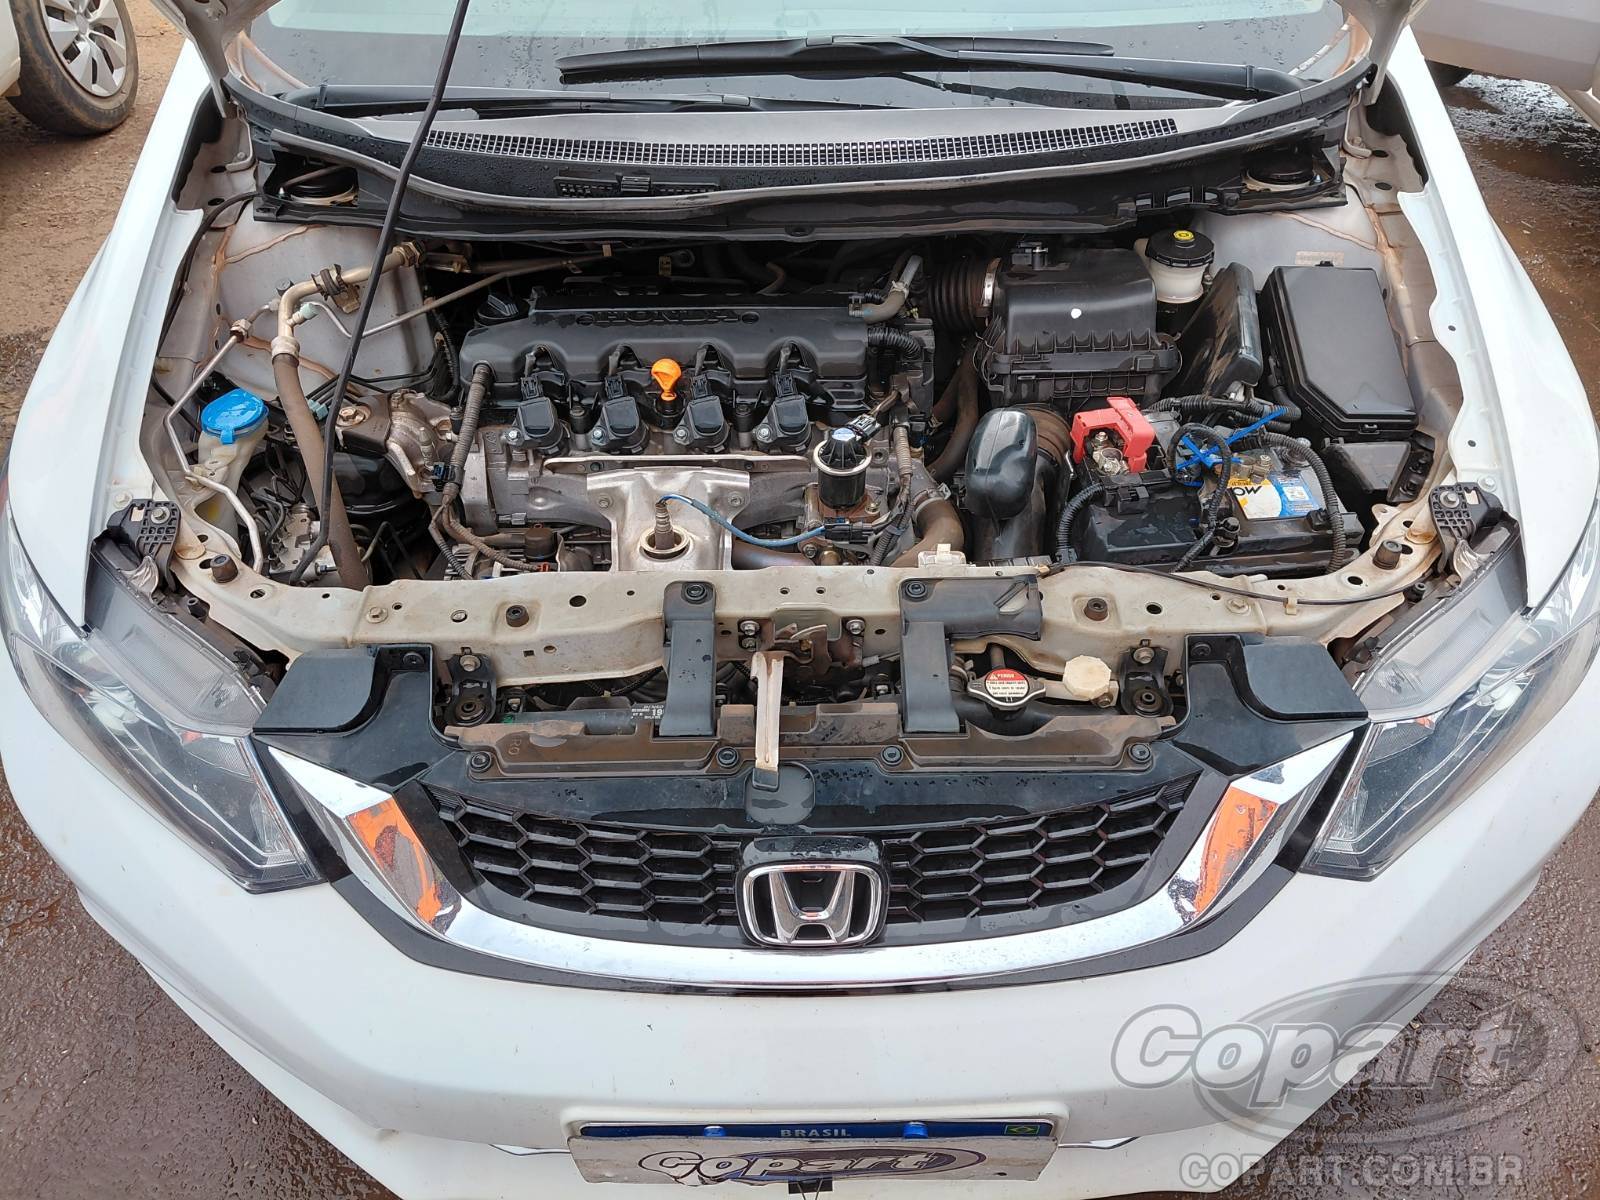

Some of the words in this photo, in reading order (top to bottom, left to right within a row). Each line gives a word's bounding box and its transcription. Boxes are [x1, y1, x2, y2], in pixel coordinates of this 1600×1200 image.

[595, 310, 739, 323] HONDA
[780, 1128, 852, 1137] BRASIL
[639, 1150, 938, 1179] Copart
